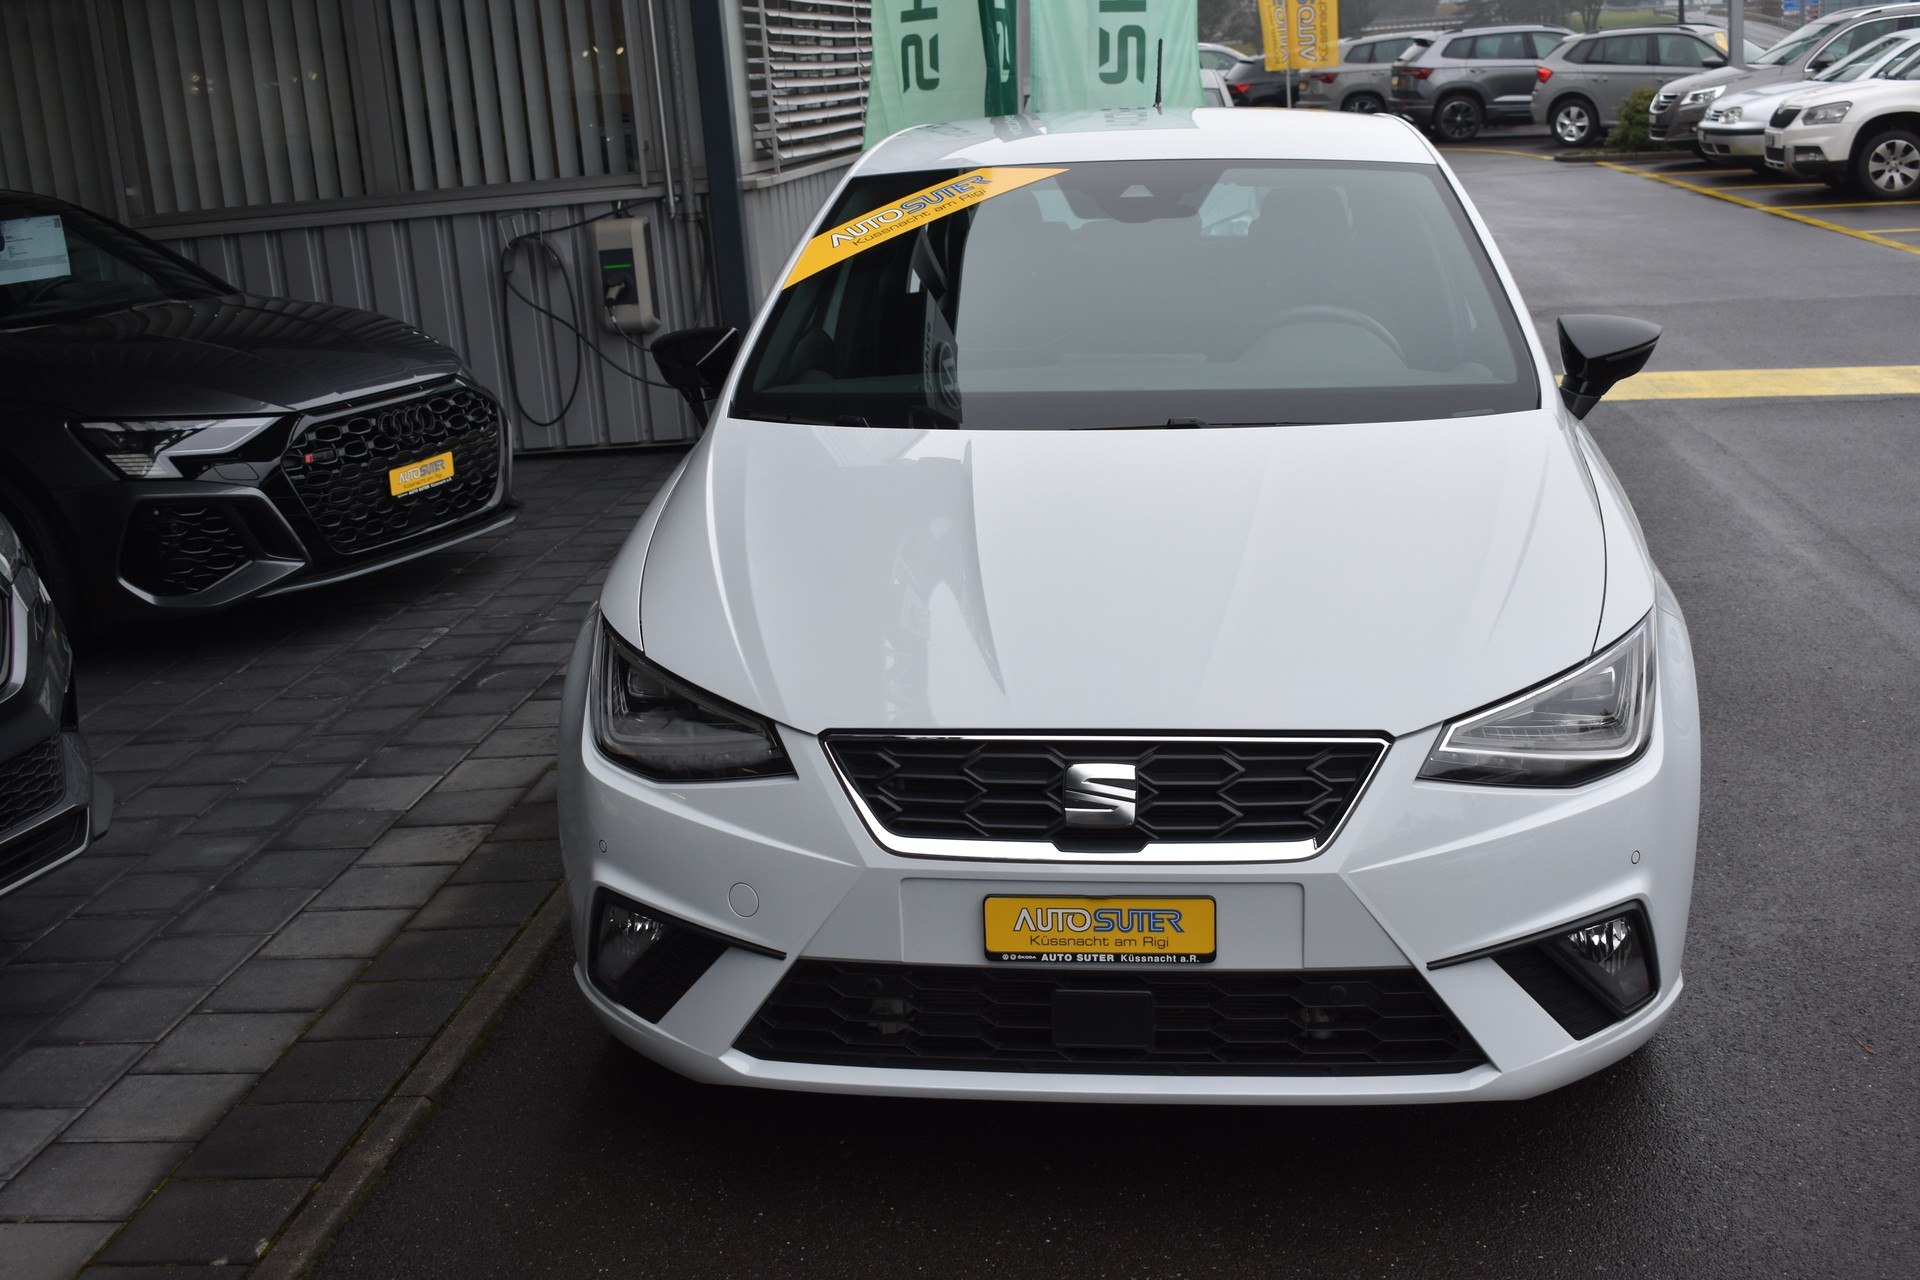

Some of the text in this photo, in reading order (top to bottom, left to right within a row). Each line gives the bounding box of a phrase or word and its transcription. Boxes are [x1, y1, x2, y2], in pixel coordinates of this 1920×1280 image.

[852, 188, 987, 246] Küssnacht am Rigi
[1030, 935, 1169, 949] Küssnacht am Rigi
[1041, 953, 1072, 962] AUTO
[1076, 953, 1115, 962] SUTER
[1120, 953, 1177, 963] Küssnacht
[1180, 954, 1200, 963] a.R.
